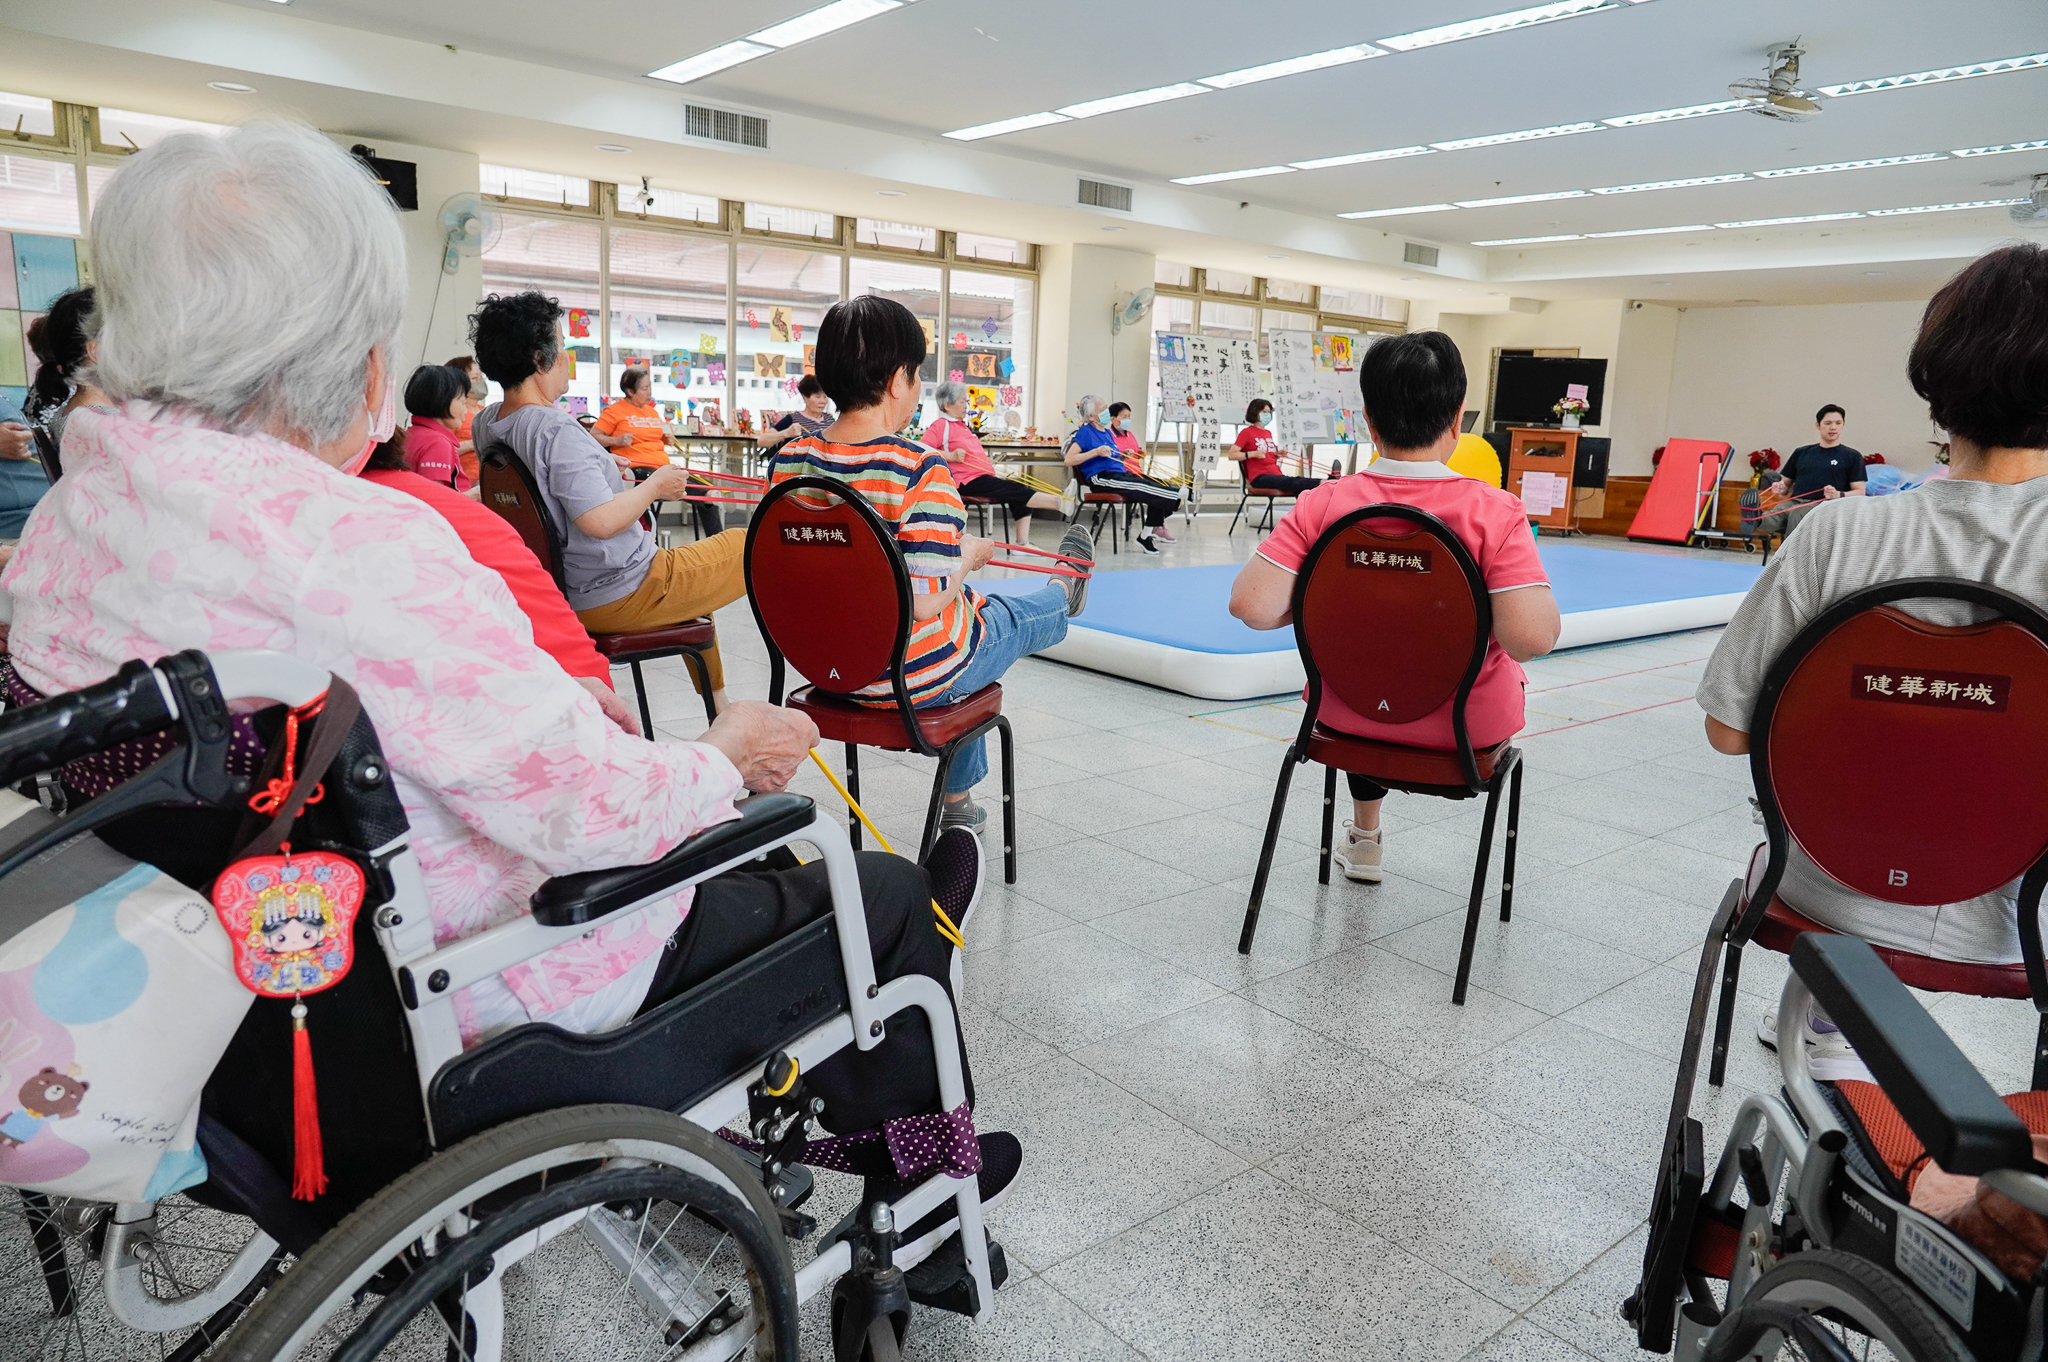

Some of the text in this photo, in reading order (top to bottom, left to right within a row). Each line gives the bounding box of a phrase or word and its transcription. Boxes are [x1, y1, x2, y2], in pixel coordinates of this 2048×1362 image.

[1217, 348, 1230, 374] 心事
[784, 526, 847, 543] 健華新城
[1351, 550, 1425, 571] 健華新城
[829, 667, 841, 680] A
[1863, 674, 1996, 706] 健華新城
[1377, 699, 1390, 711] A
[1888, 869, 1909, 887] B
